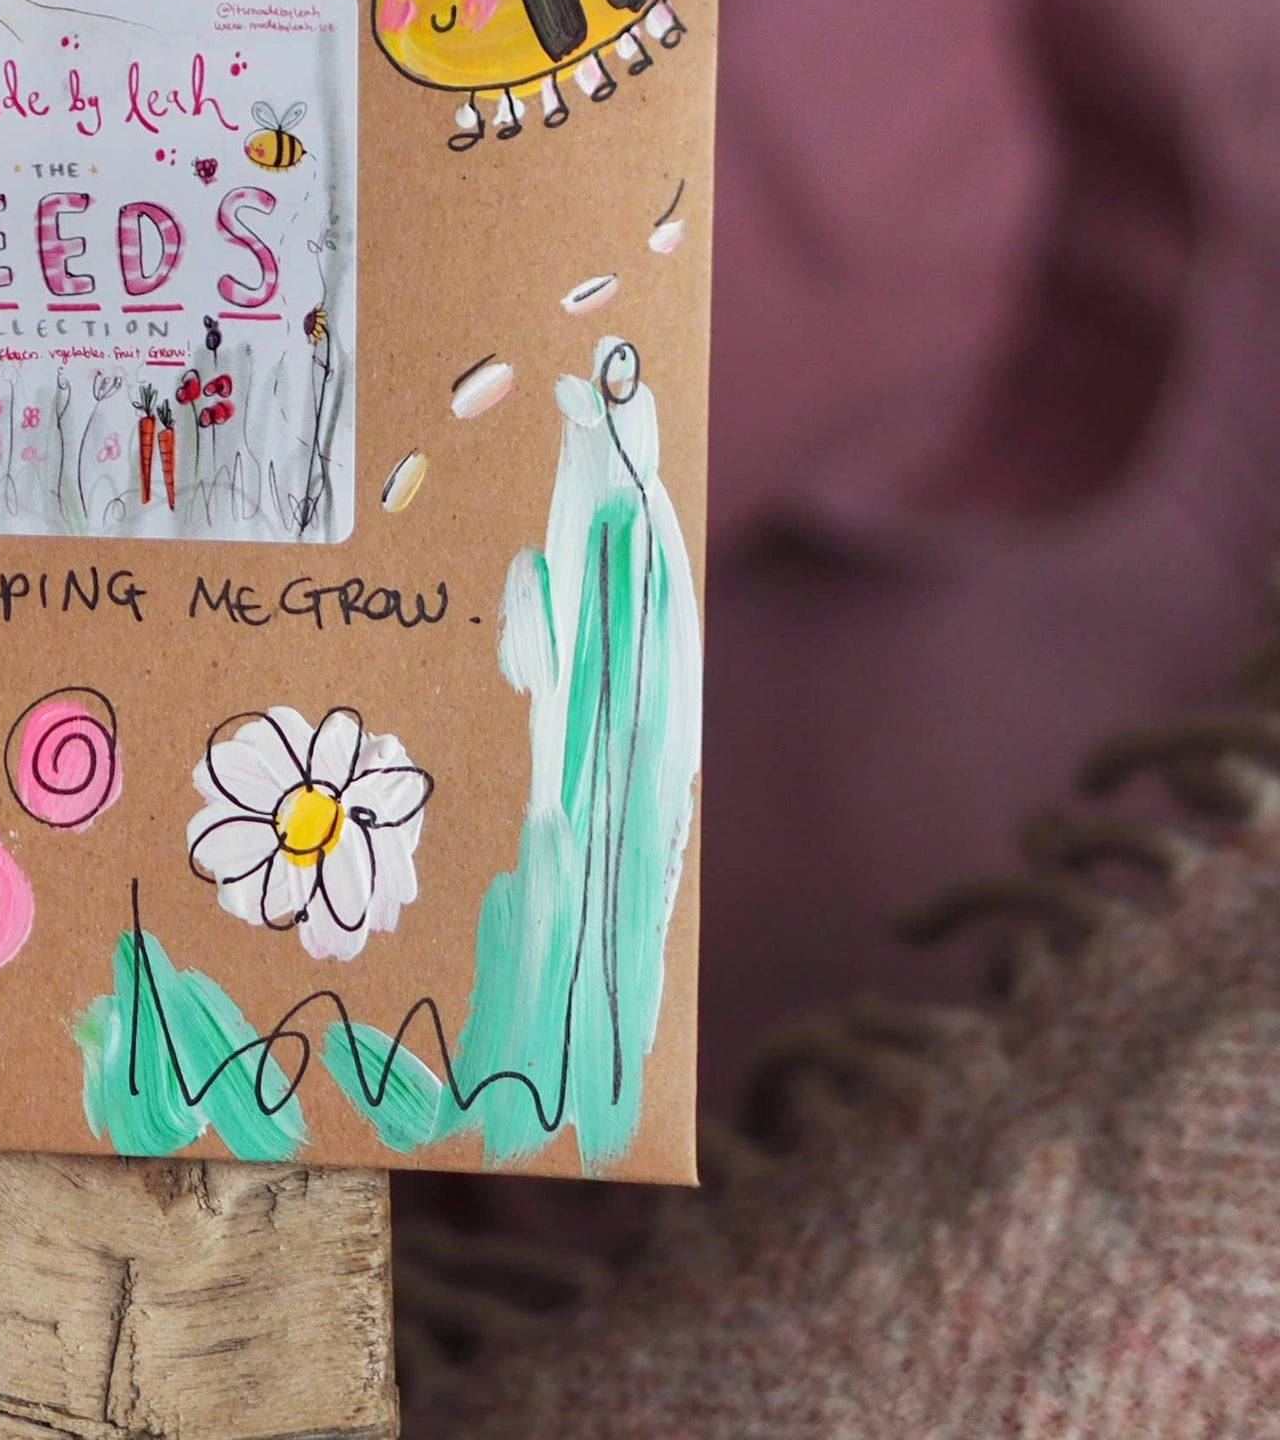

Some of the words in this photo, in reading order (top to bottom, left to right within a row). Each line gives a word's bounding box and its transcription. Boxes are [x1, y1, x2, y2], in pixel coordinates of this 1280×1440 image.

[68, 69, 102, 137] by
[124, 52, 240, 134] leah
[31, 162, 81, 179] THE
